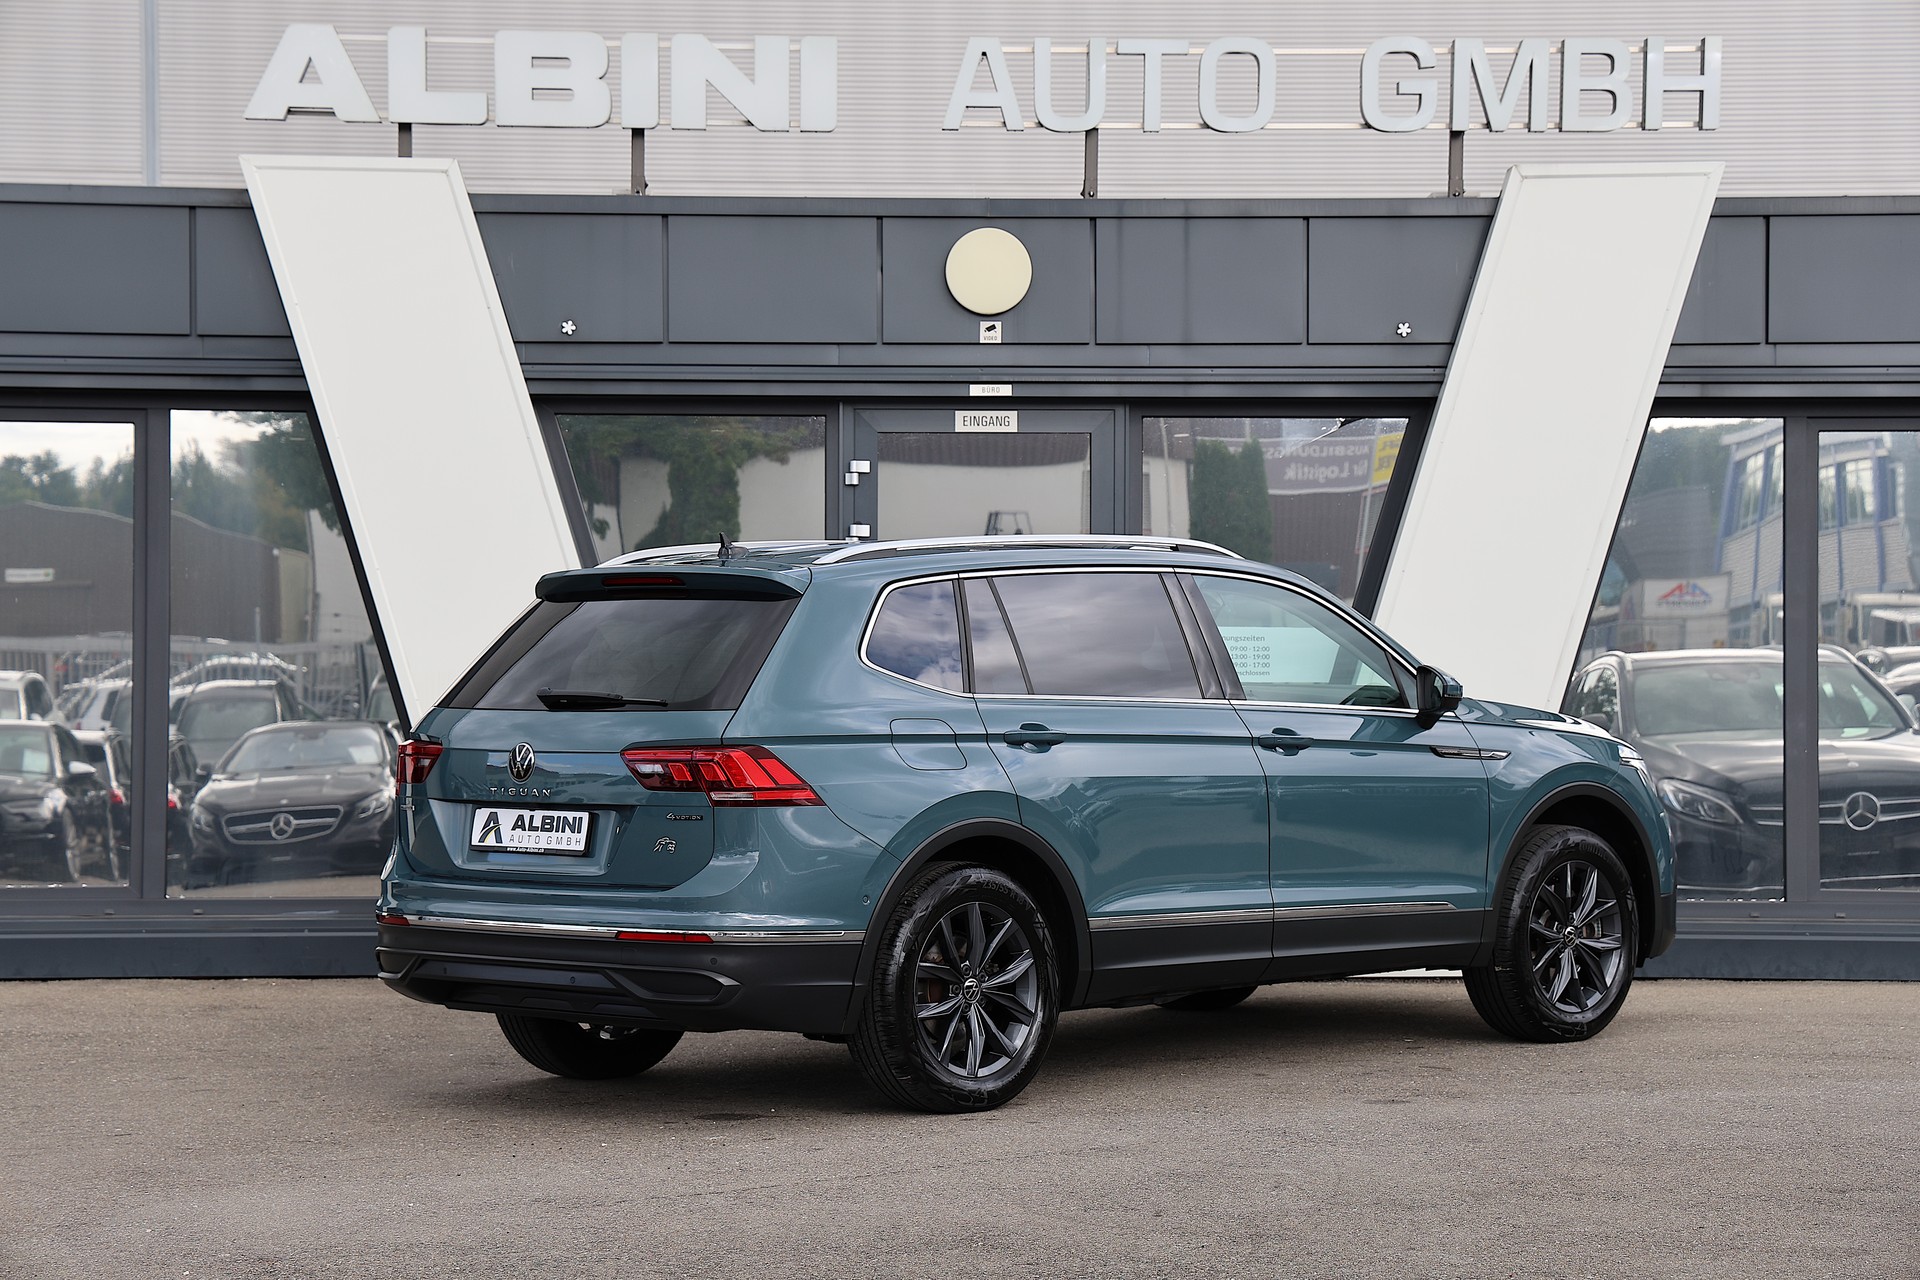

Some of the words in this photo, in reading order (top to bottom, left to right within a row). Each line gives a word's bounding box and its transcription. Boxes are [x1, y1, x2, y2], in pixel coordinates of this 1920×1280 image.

[244, 23, 839, 133] ALBINI
[942, 36, 1278, 134] AUTO
[1360, 36, 1723, 134] GMBH
[981, 386, 1001, 394] BÜRO
[962, 415, 1011, 427] EINGANG
[489, 786, 552, 798] TIGUAN
[666, 812, 702, 821] 4MOTION
[511, 813, 583, 834] ALBINI
[509, 834, 541, 845] AUTO
[546, 835, 582, 847] GMBH
[982, 880, 1009, 894] 235/55
